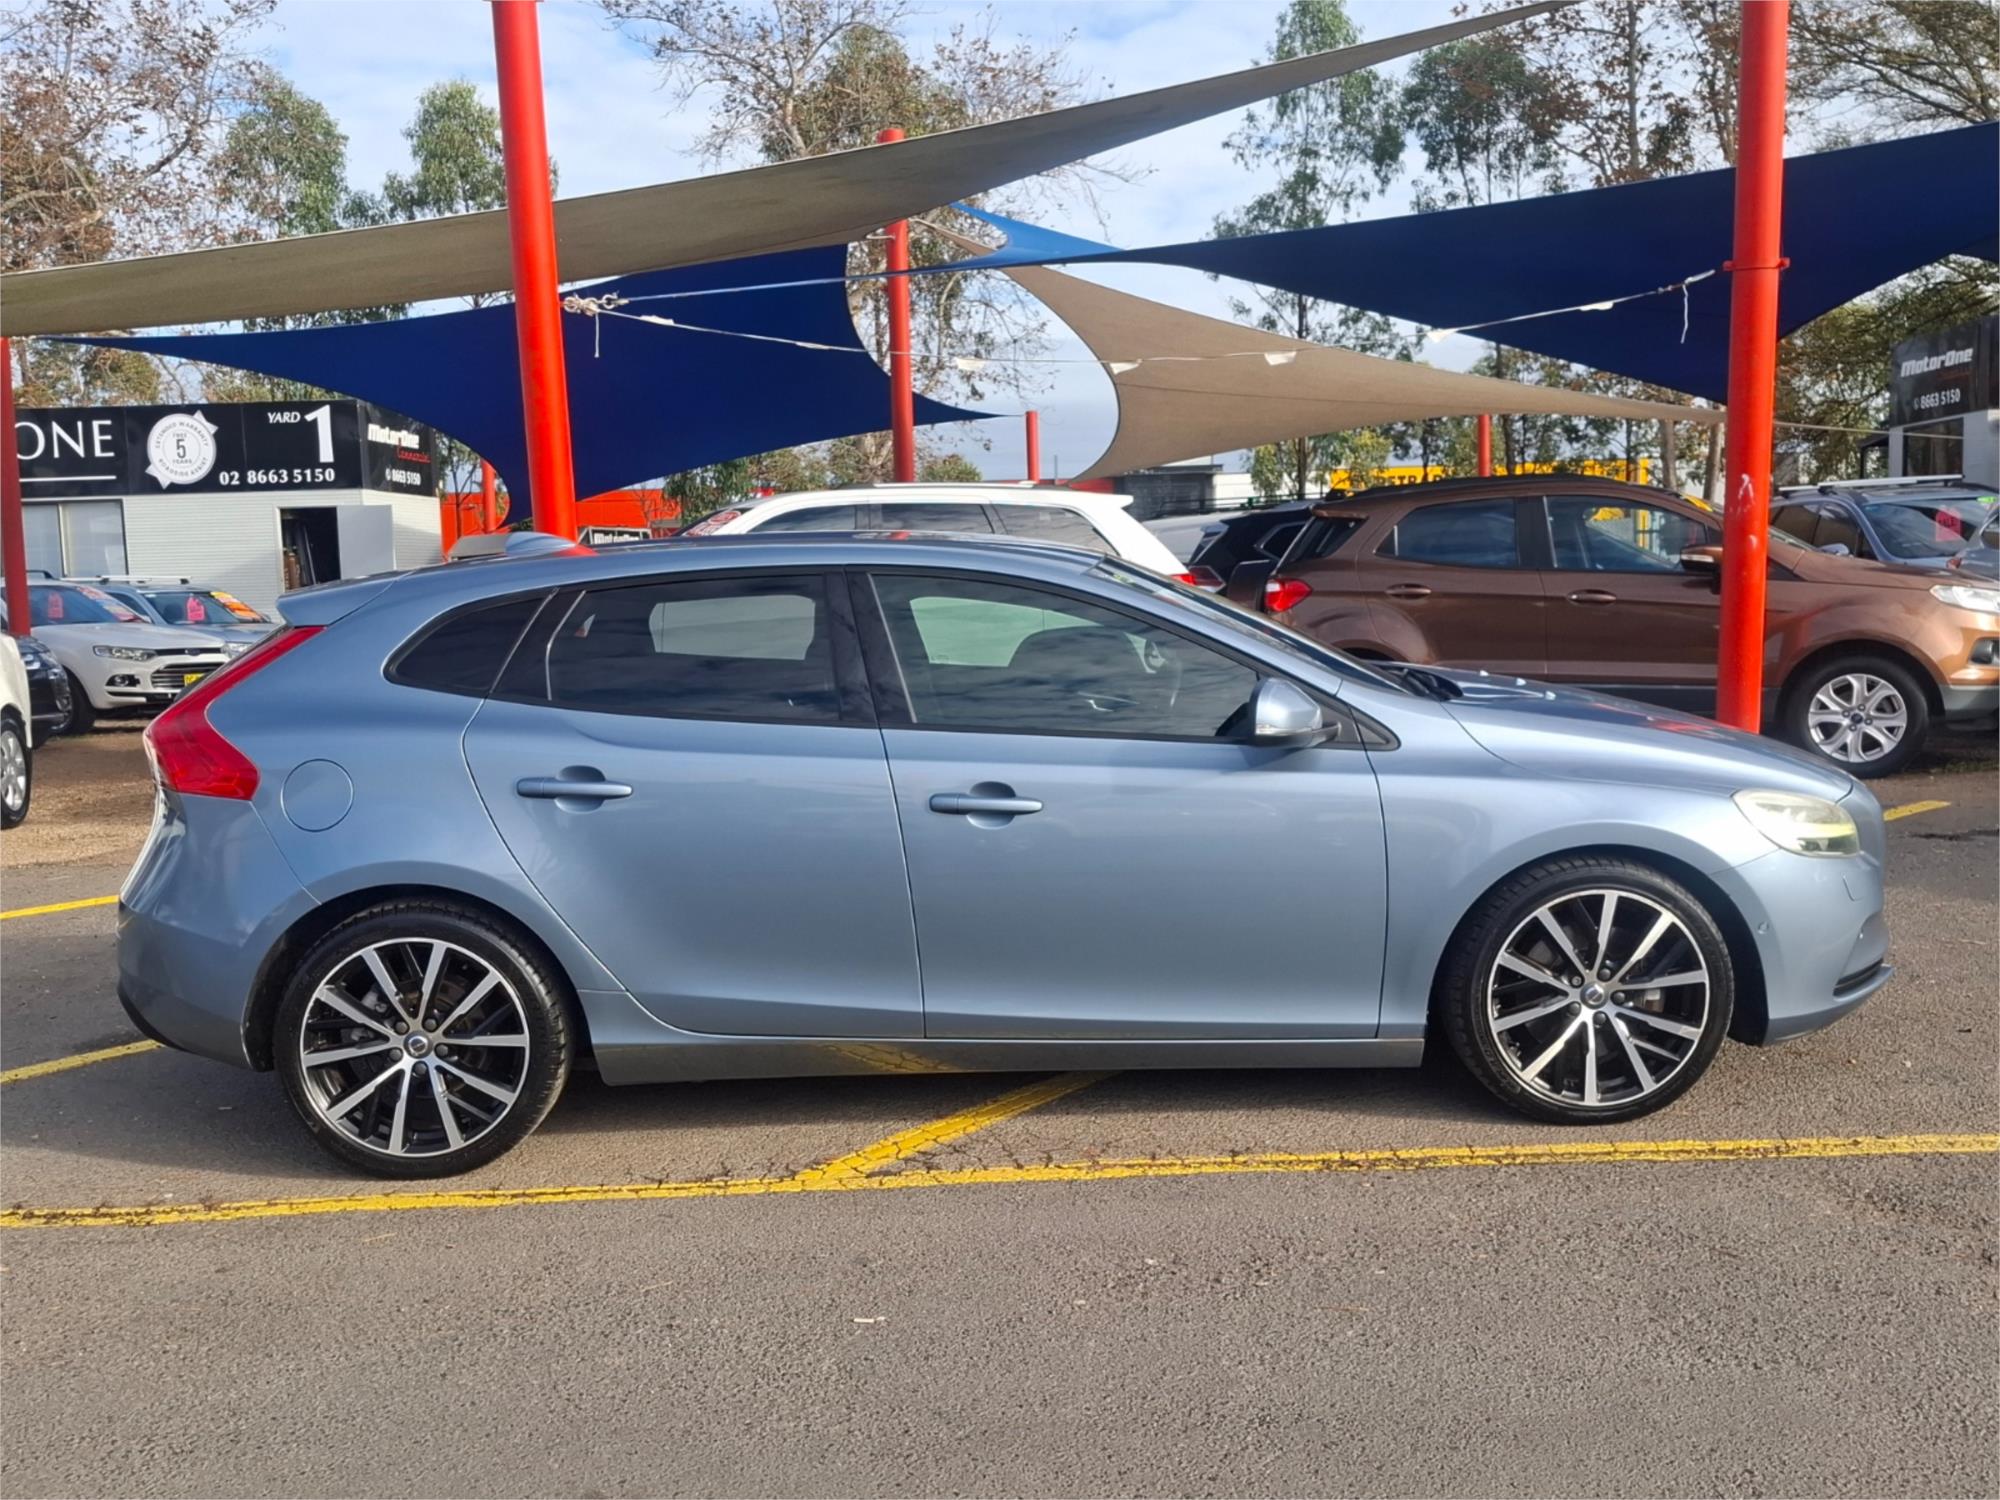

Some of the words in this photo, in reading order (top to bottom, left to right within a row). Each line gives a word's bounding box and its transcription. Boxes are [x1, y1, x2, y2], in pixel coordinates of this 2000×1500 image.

[1901, 347, 1974, 378] MotorOne
[1920, 392, 1940, 410] 8663
[1940, 388, 1961, 406] 5150
[14, 420, 115, 460] ONE
[179, 421, 208, 447] WARRANTY
[267, 411, 301, 424] YARD
[304, 404, 334, 463] 1
[176, 438, 186, 459] 5
[219, 470, 240, 485] 02
[246, 469, 289, 484] 8663
[292, 467, 336, 483] 5150
